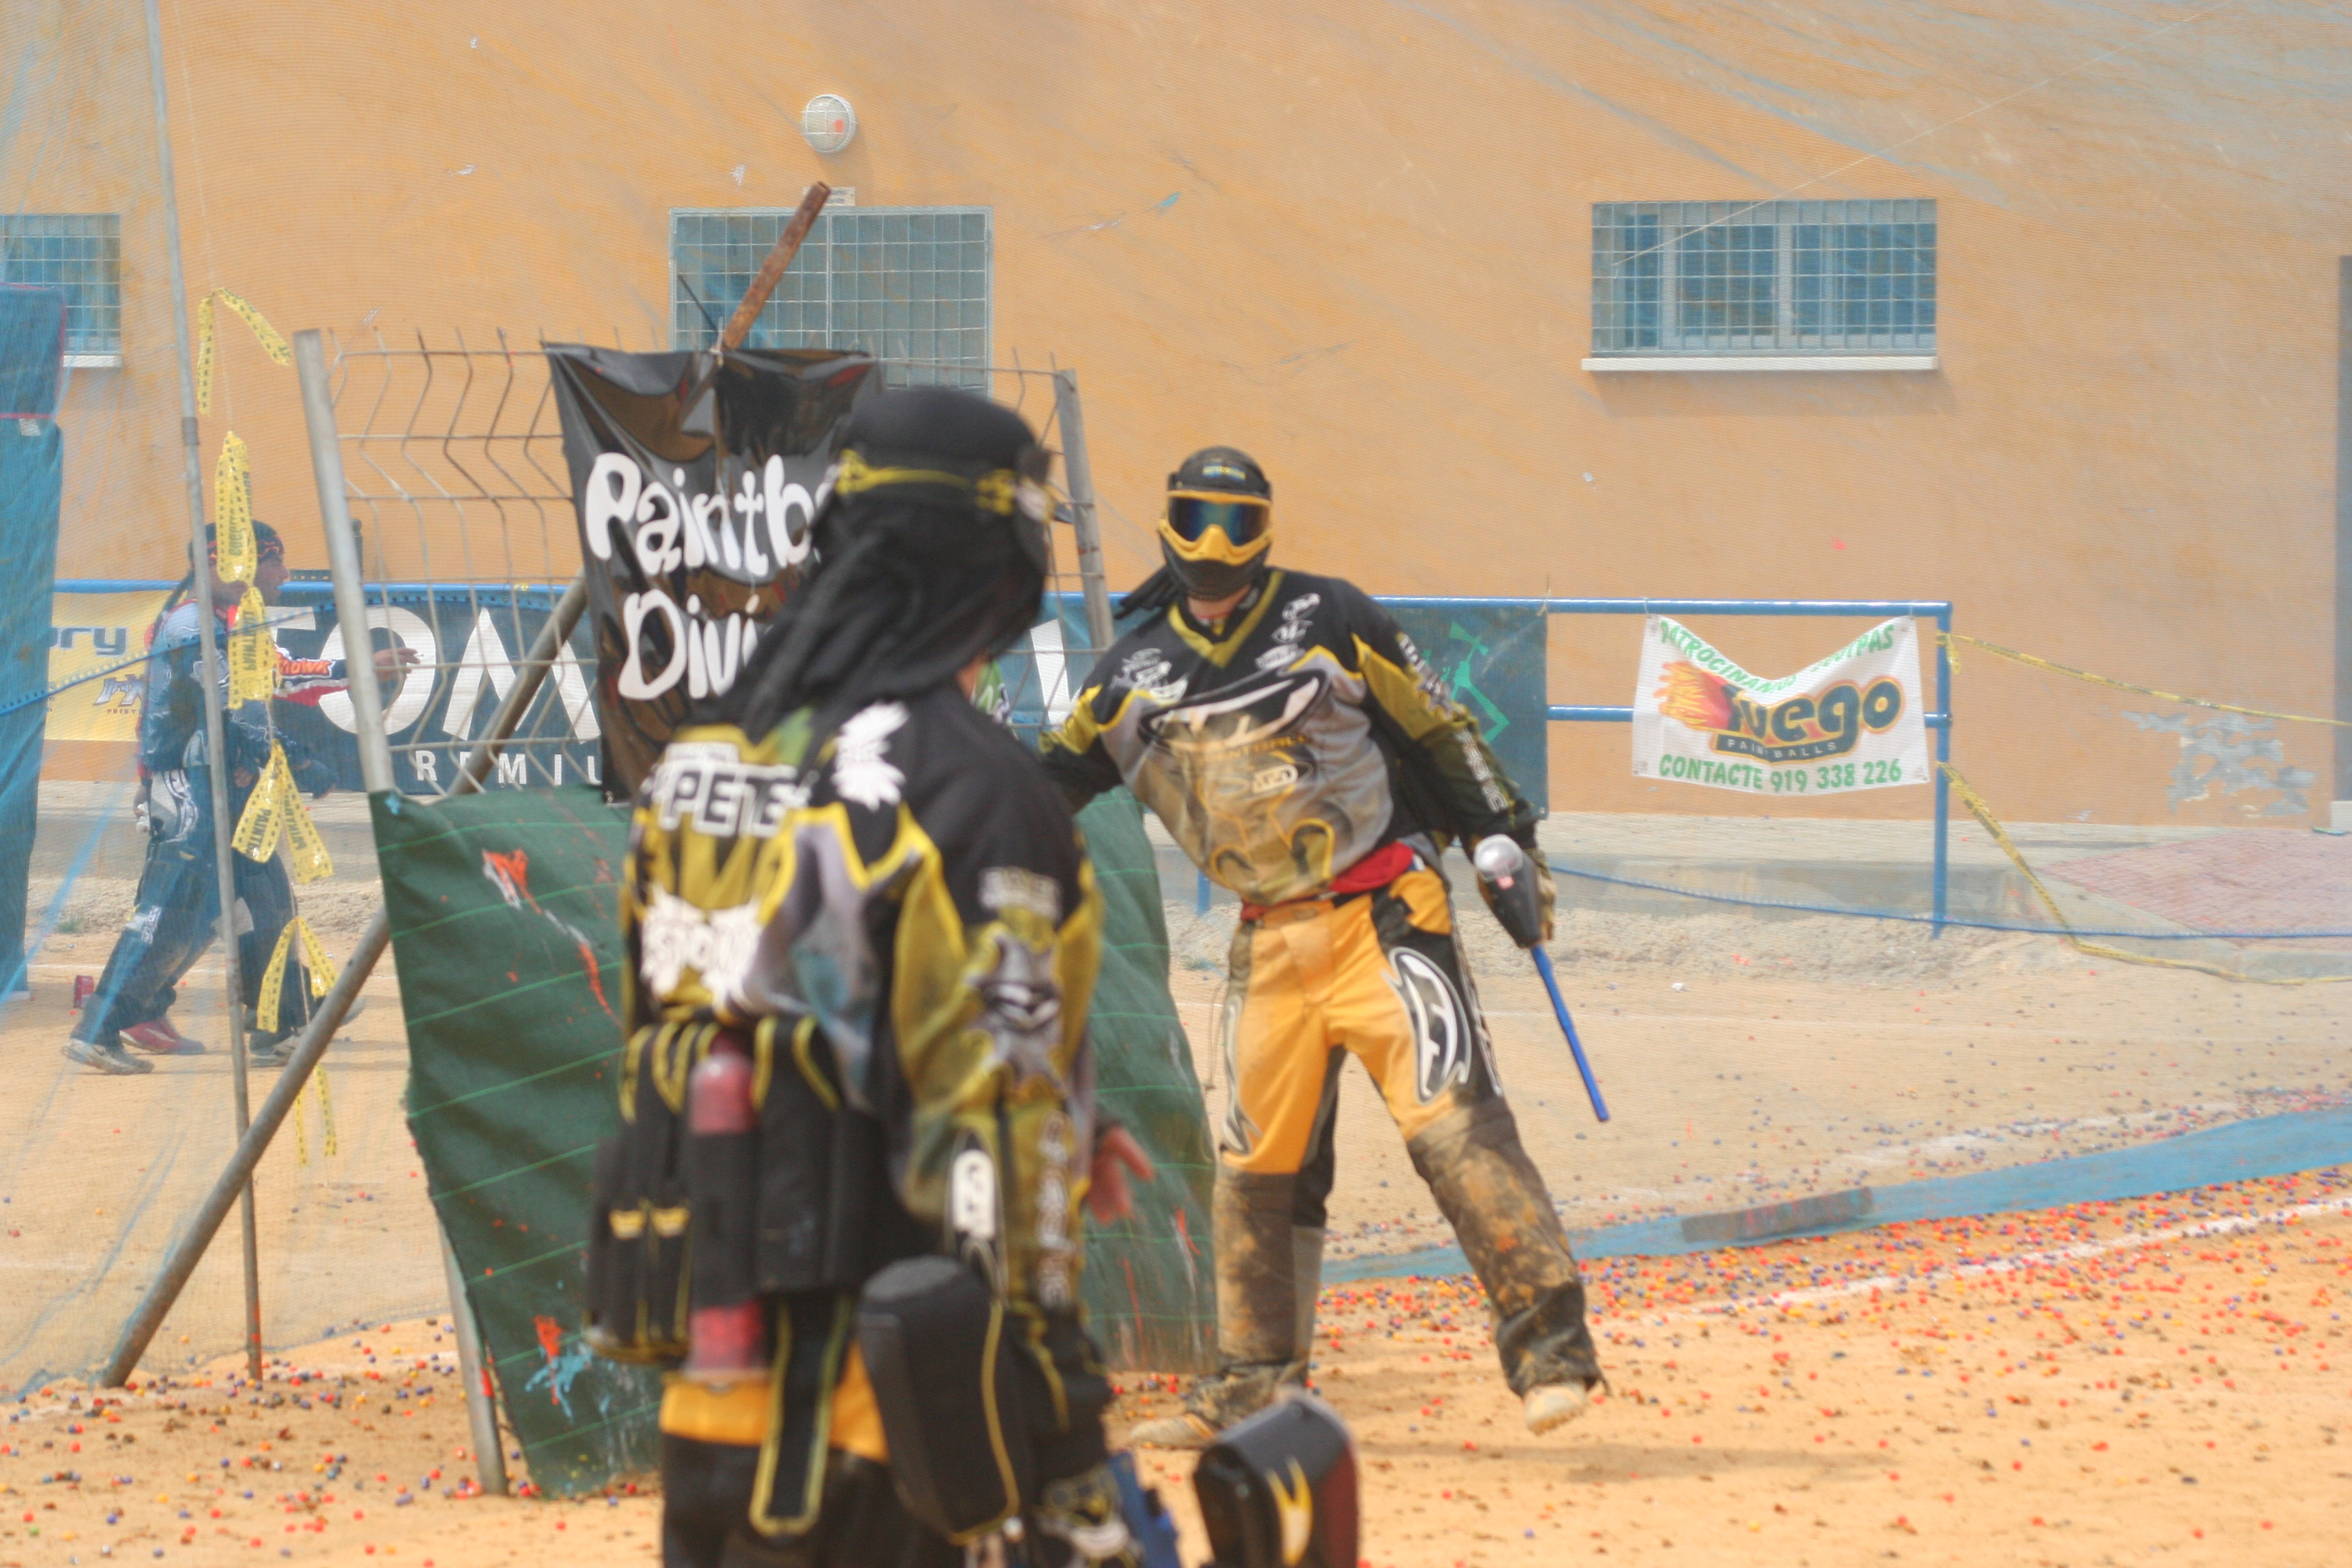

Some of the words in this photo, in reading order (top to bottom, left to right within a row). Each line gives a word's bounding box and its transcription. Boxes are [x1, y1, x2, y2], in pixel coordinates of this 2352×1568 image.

[50, 627, 127, 656] ry
[618, 588, 769, 698] Divi
[1727, 738, 1836, 759] PAINBALLS
[1659, 754, 1763, 789] CONTACTE
[1771, 764, 1808, 792] 919
[1817, 756, 1855, 789] 338
[1863, 751, 1902, 785] 226
